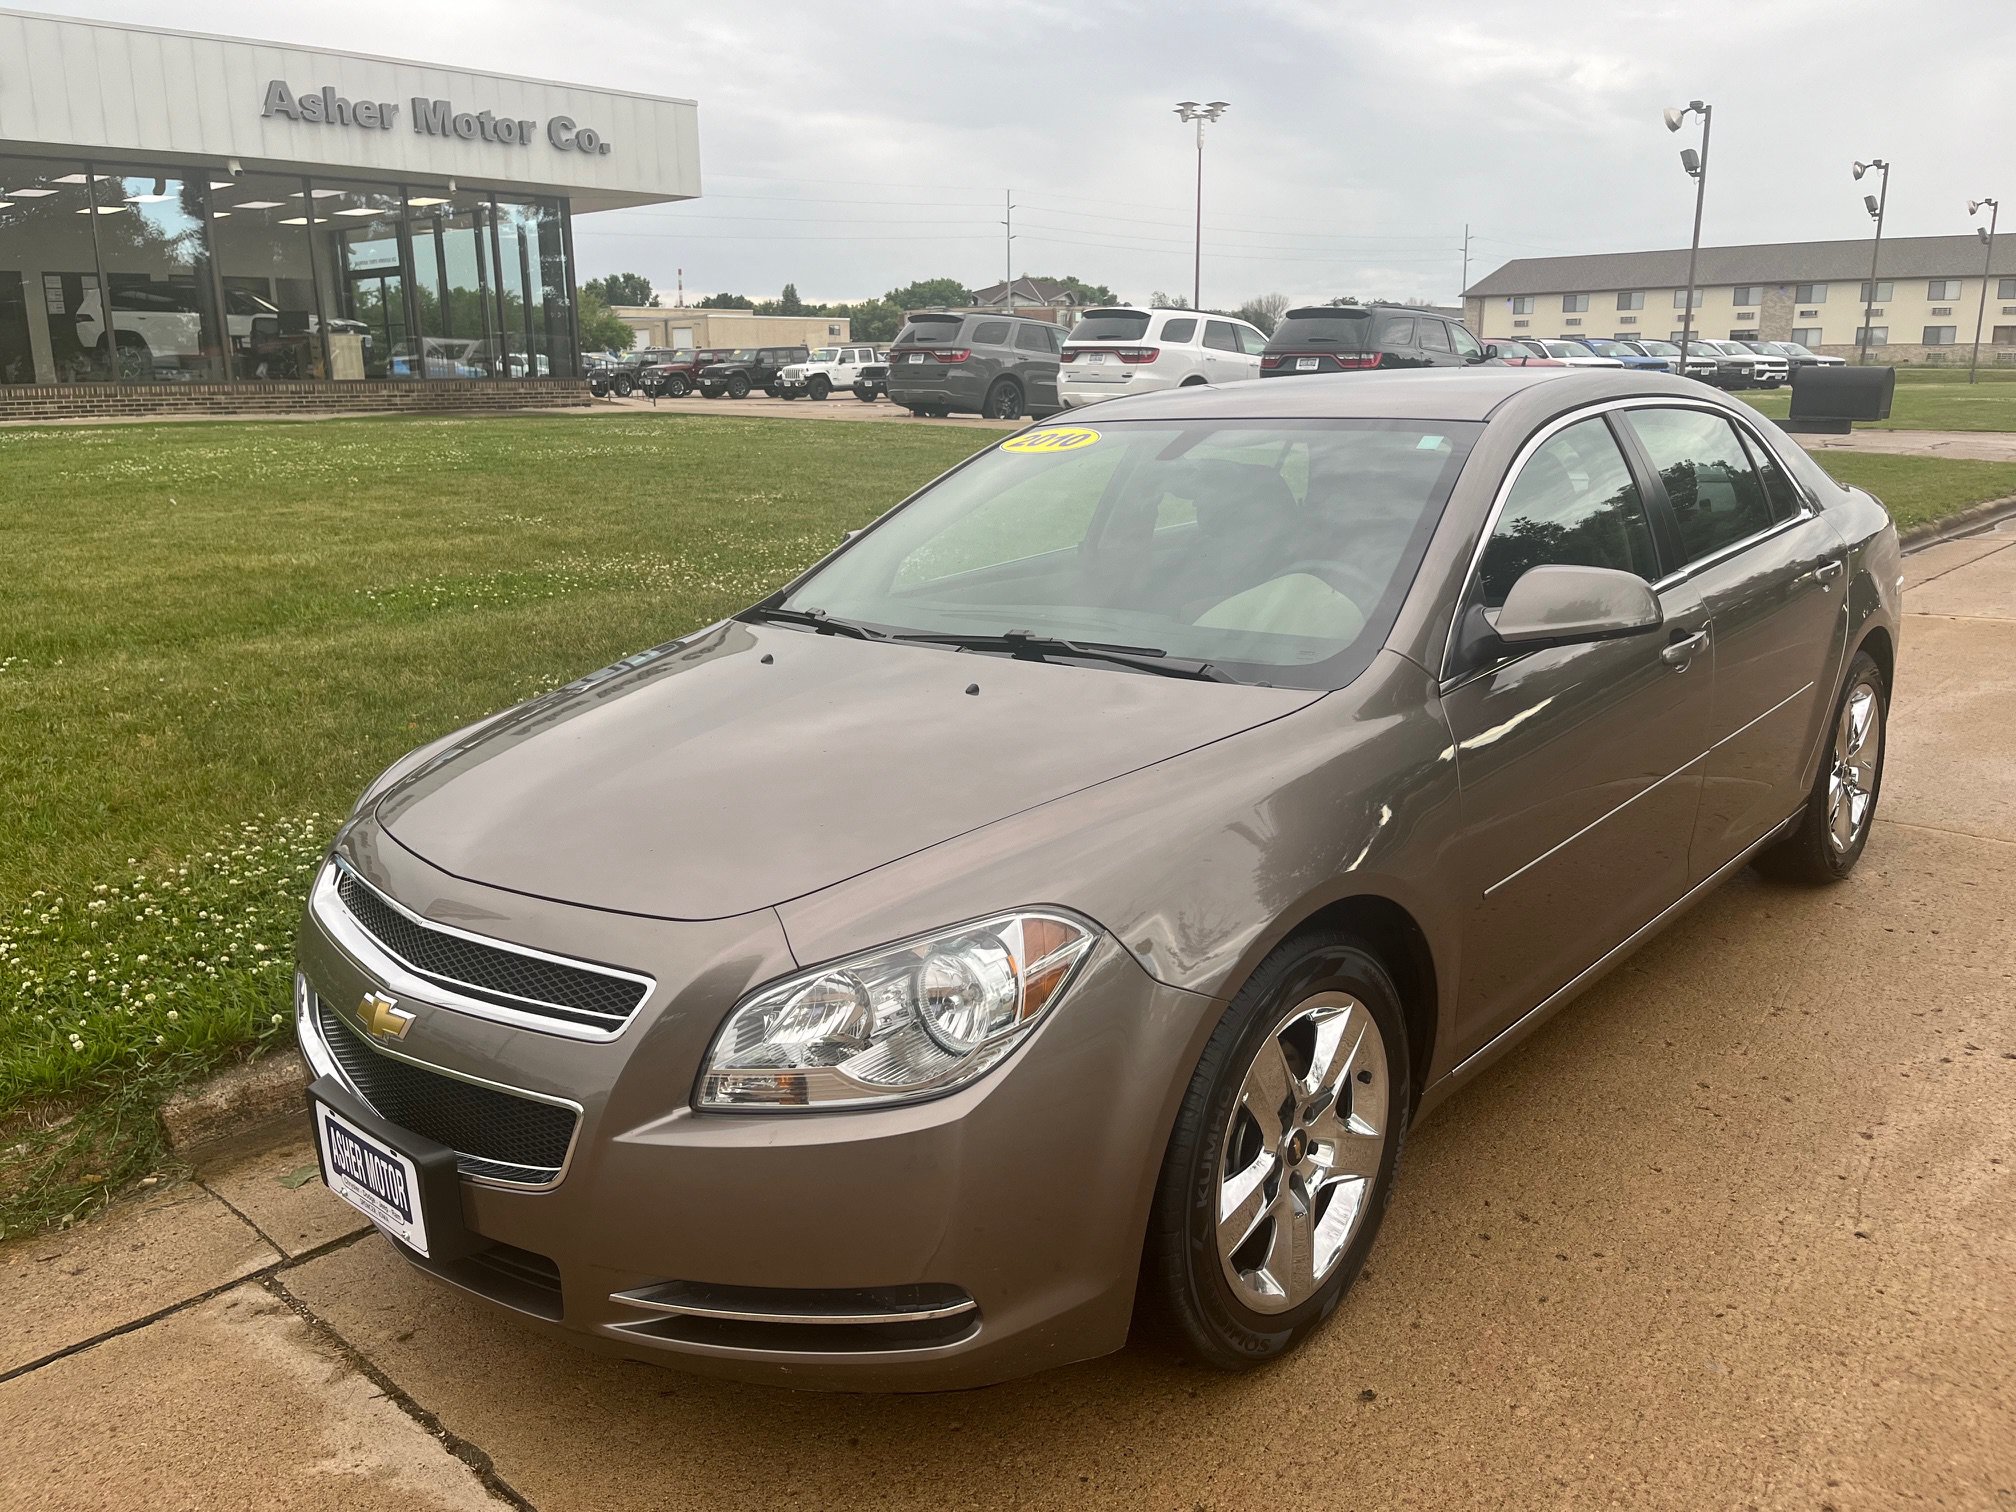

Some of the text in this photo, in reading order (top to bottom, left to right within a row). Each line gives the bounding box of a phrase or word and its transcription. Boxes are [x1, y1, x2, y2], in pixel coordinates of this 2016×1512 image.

[261, 80, 612, 154] Asher Motor Co.
[1006, 432, 1092, 448] 2010
[330, 1126, 368, 1185] ASHER
[363, 1150, 409, 1212] MOTOR
[1196, 1086, 1233, 1209] KUMHO
